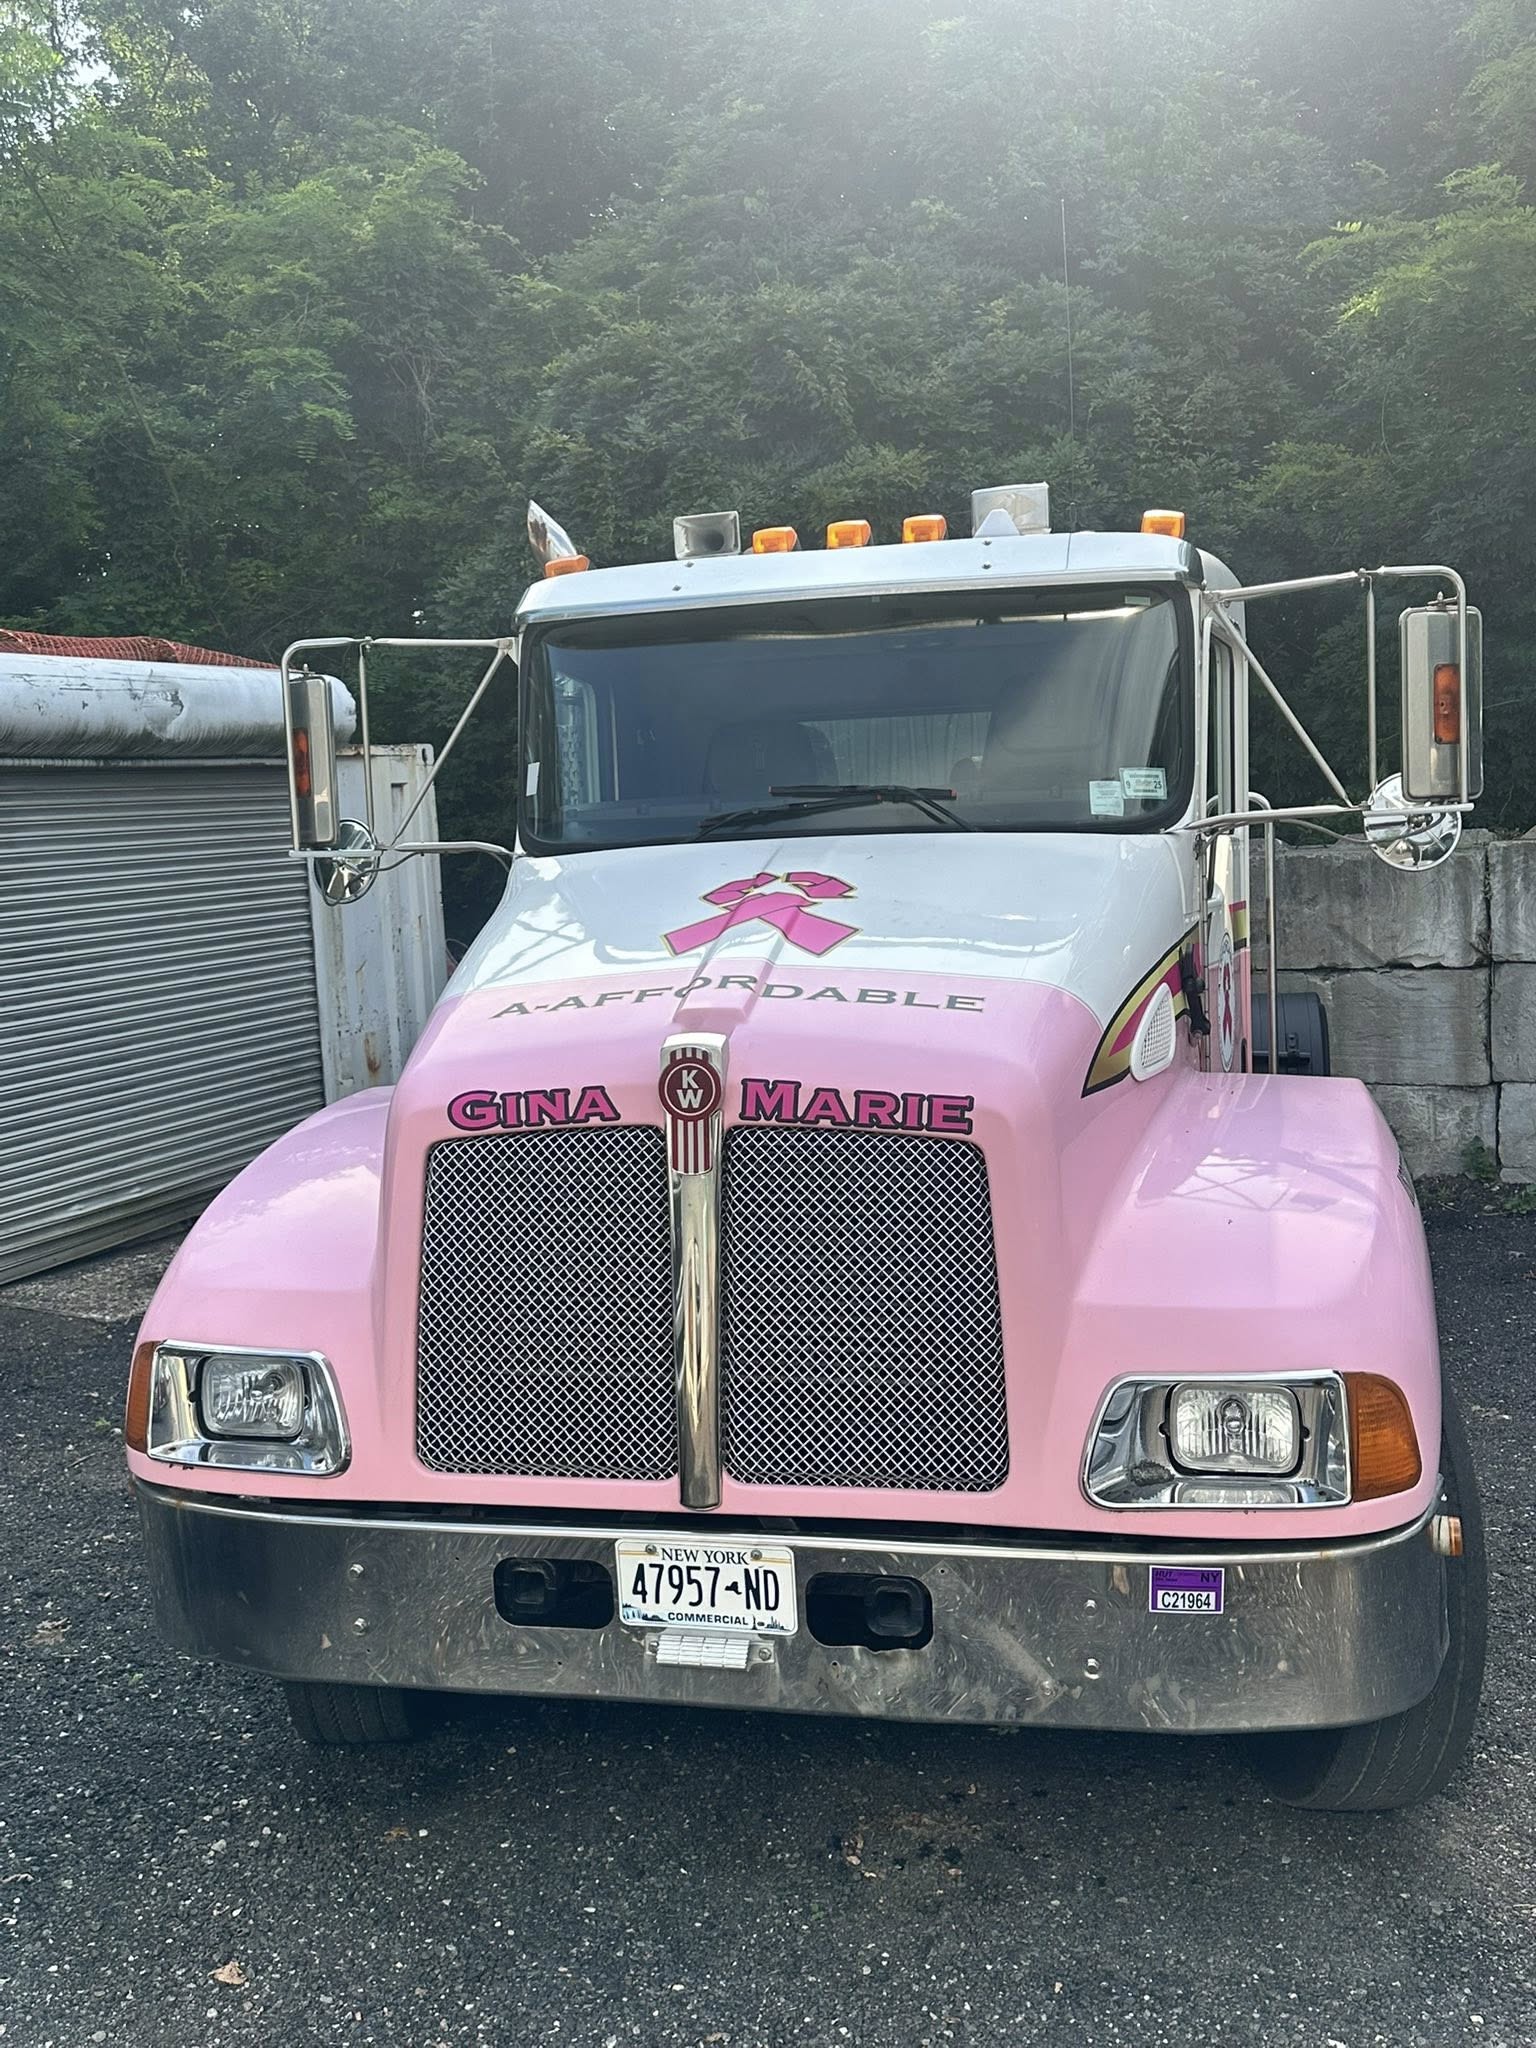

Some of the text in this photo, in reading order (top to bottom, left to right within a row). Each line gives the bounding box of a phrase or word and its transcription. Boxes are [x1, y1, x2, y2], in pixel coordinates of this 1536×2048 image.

[489, 975, 985, 1019] A-AFFORDABLE
[448, 1078, 974, 1135] GINA MARIE
[661, 1547, 749, 1565] NEW YORK
[1200, 1572, 1220, 1583] NY
[1161, 1591, 1211, 1609] C21964
[667, 1612, 749, 1626] COMMERCIAL
